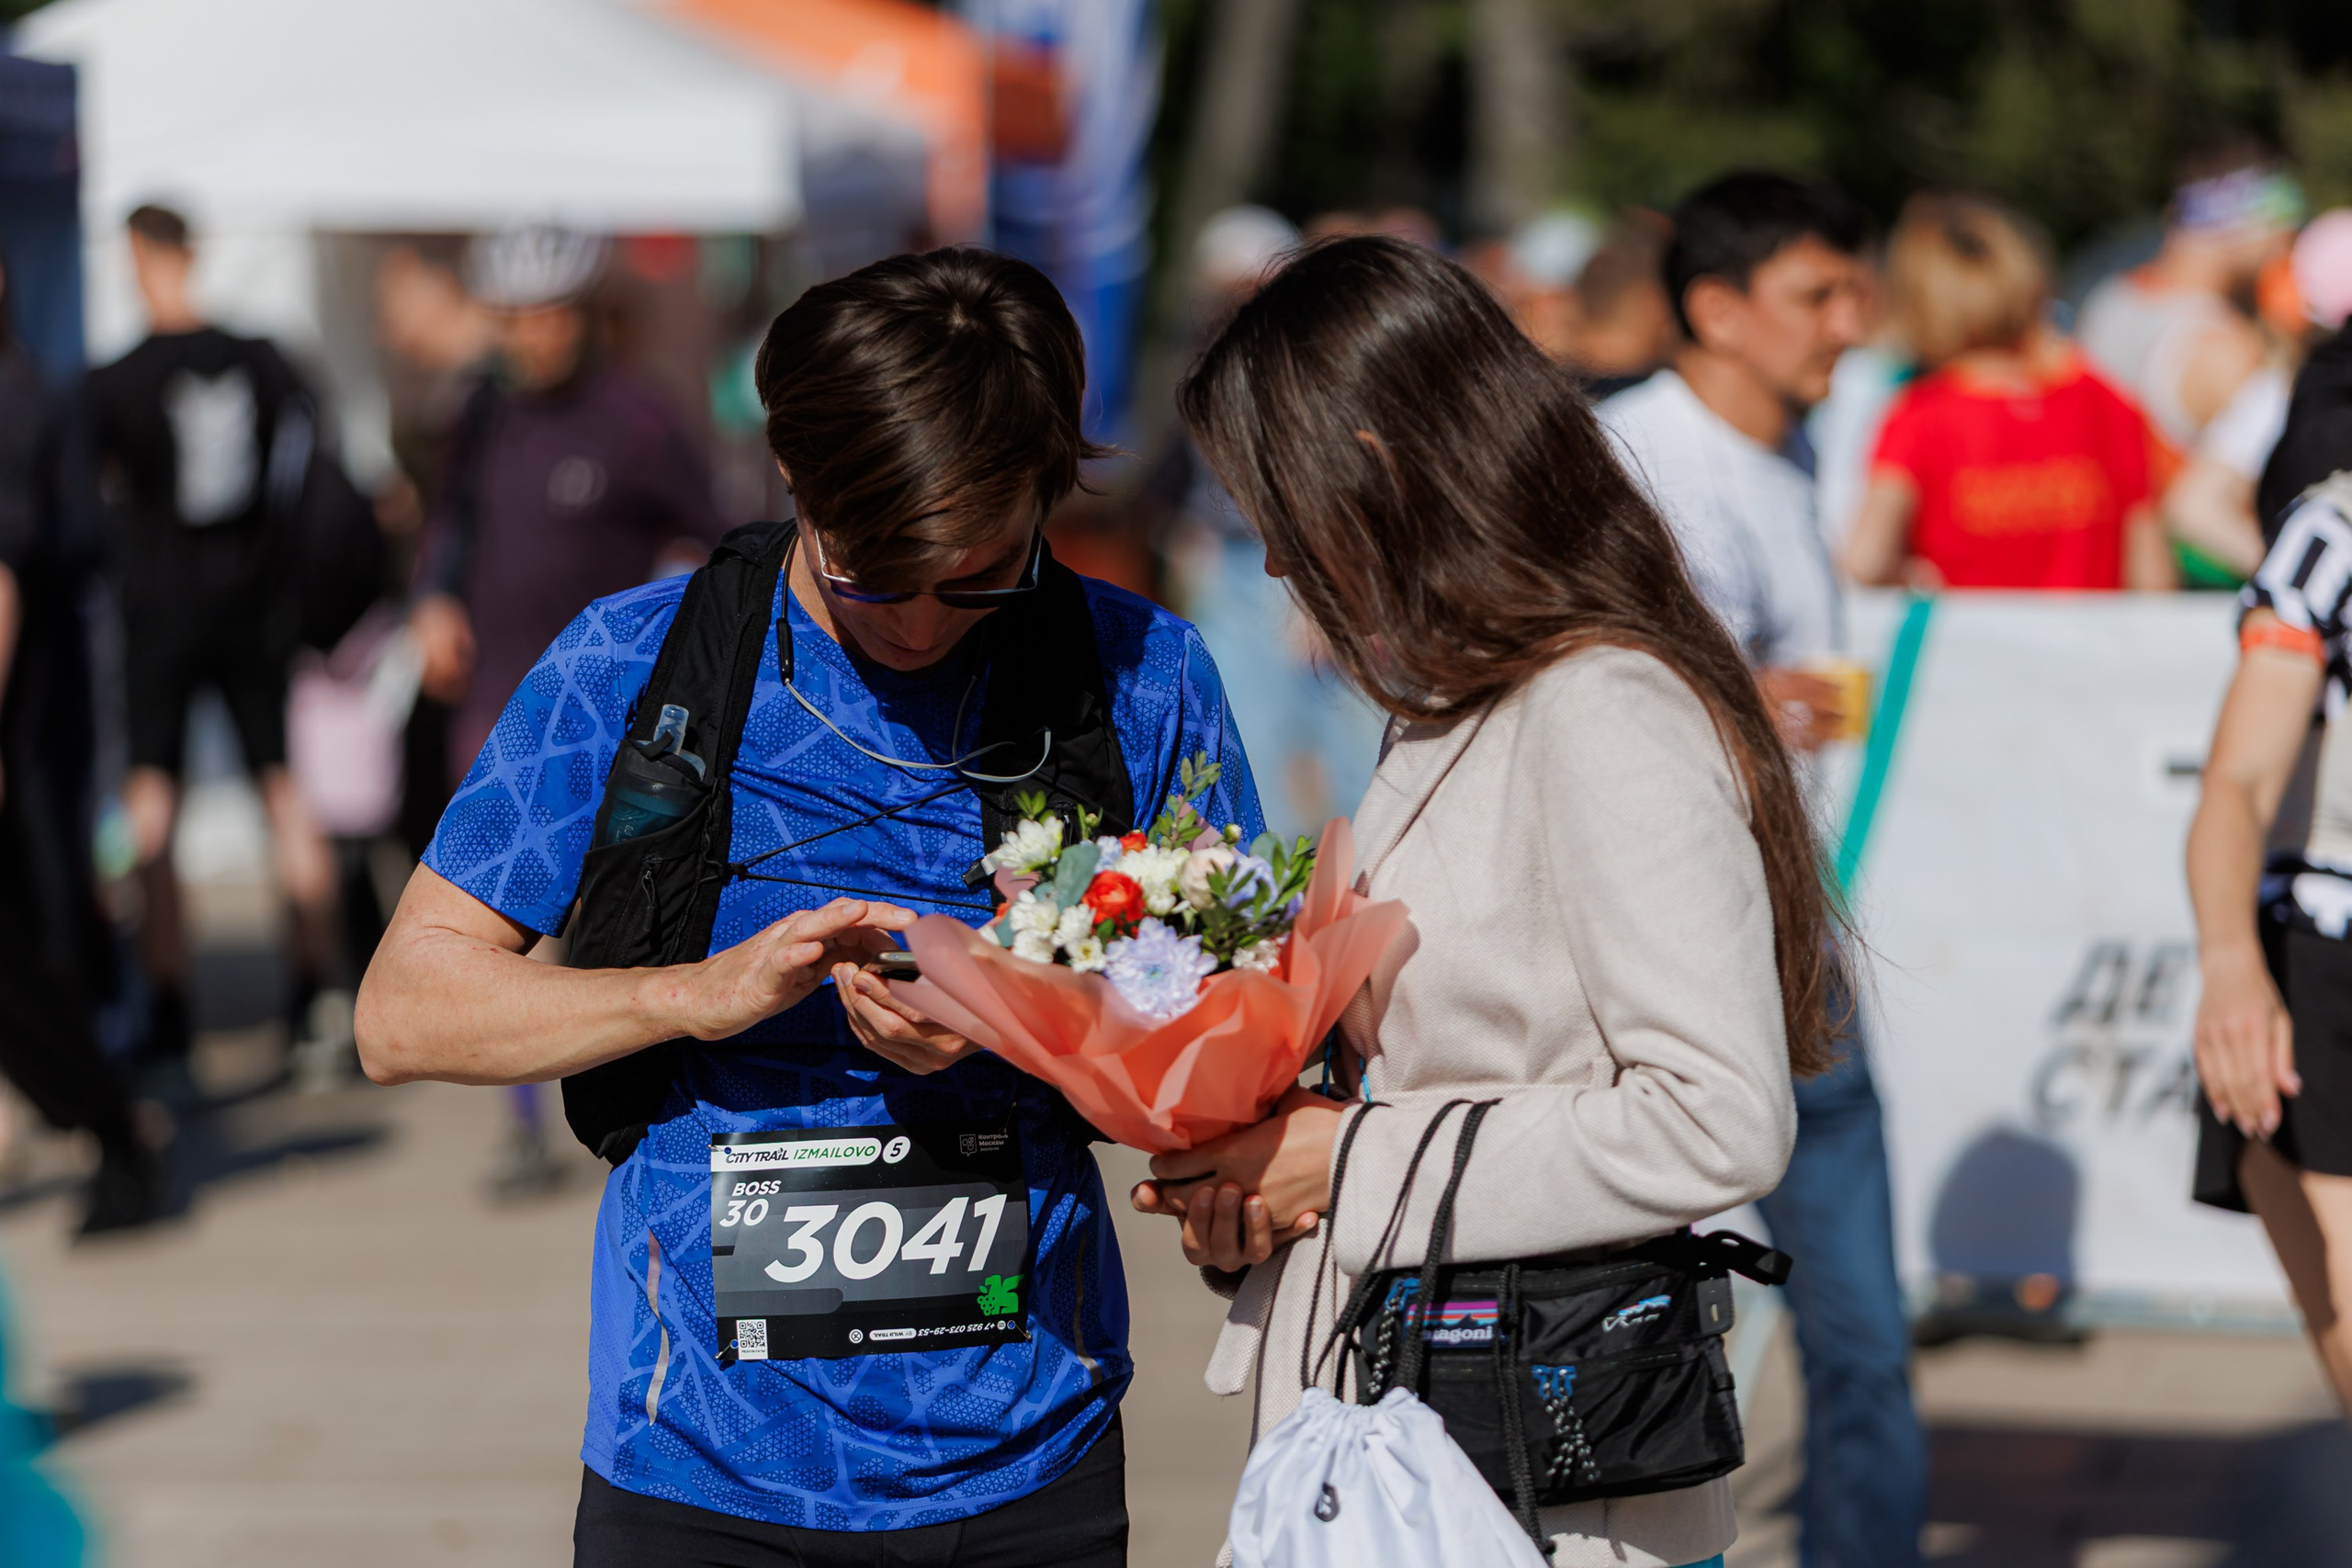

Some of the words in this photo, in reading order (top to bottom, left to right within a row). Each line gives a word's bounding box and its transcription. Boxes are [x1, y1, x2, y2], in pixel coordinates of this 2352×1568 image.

[2051, 939, 2194, 1028] ДЕ
[2030, 1040, 2197, 1124] СТА
[793, 1145, 876, 1160] IZMAILOVO
[889, 1142, 903, 1157] 5
[731, 1179, 782, 1197] BOSS
[718, 1198, 769, 1227] 30
[763, 1193, 1008, 1283] 3041
[918, 1325, 967, 1337] 073-29-53
[967, 1323, 984, 1332] 925
[984, 1322, 996, 1330] +7
[1419, 1325, 1505, 1344] atagoni
